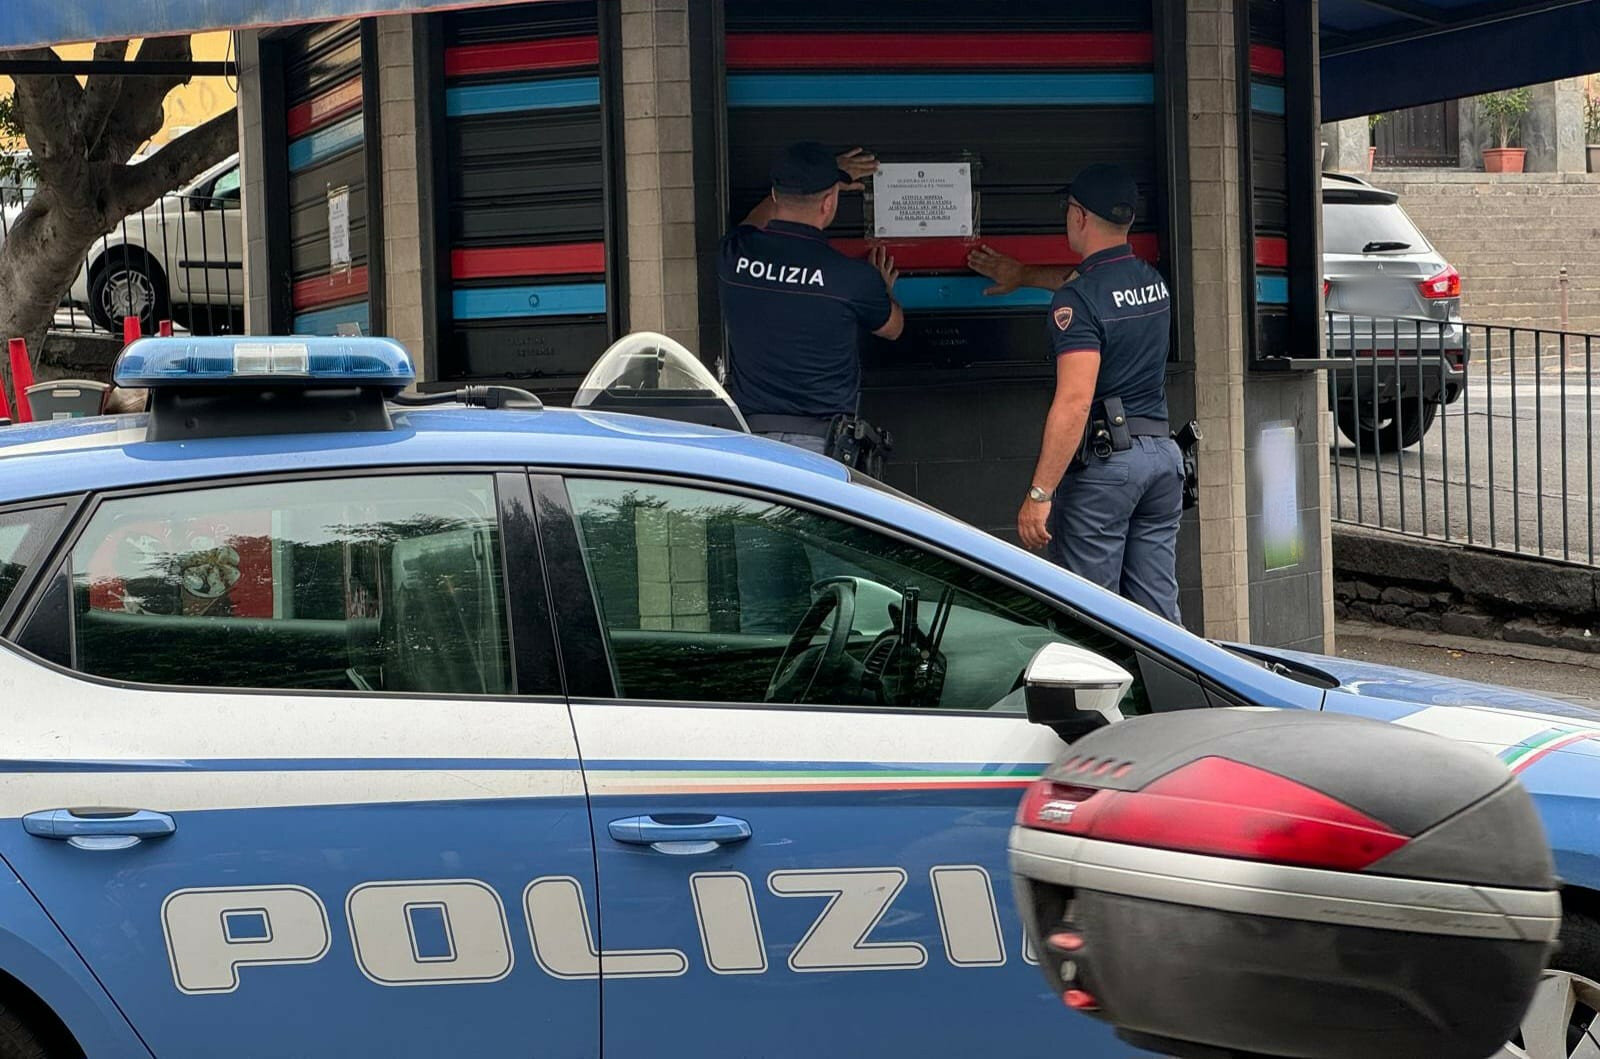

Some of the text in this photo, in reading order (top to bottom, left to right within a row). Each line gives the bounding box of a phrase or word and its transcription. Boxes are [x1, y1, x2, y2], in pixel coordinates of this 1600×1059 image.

[736, 257, 825, 287] POLIZIA
[1112, 281, 1169, 308] POLIZIA
[160, 865, 1040, 994] POLIZI
